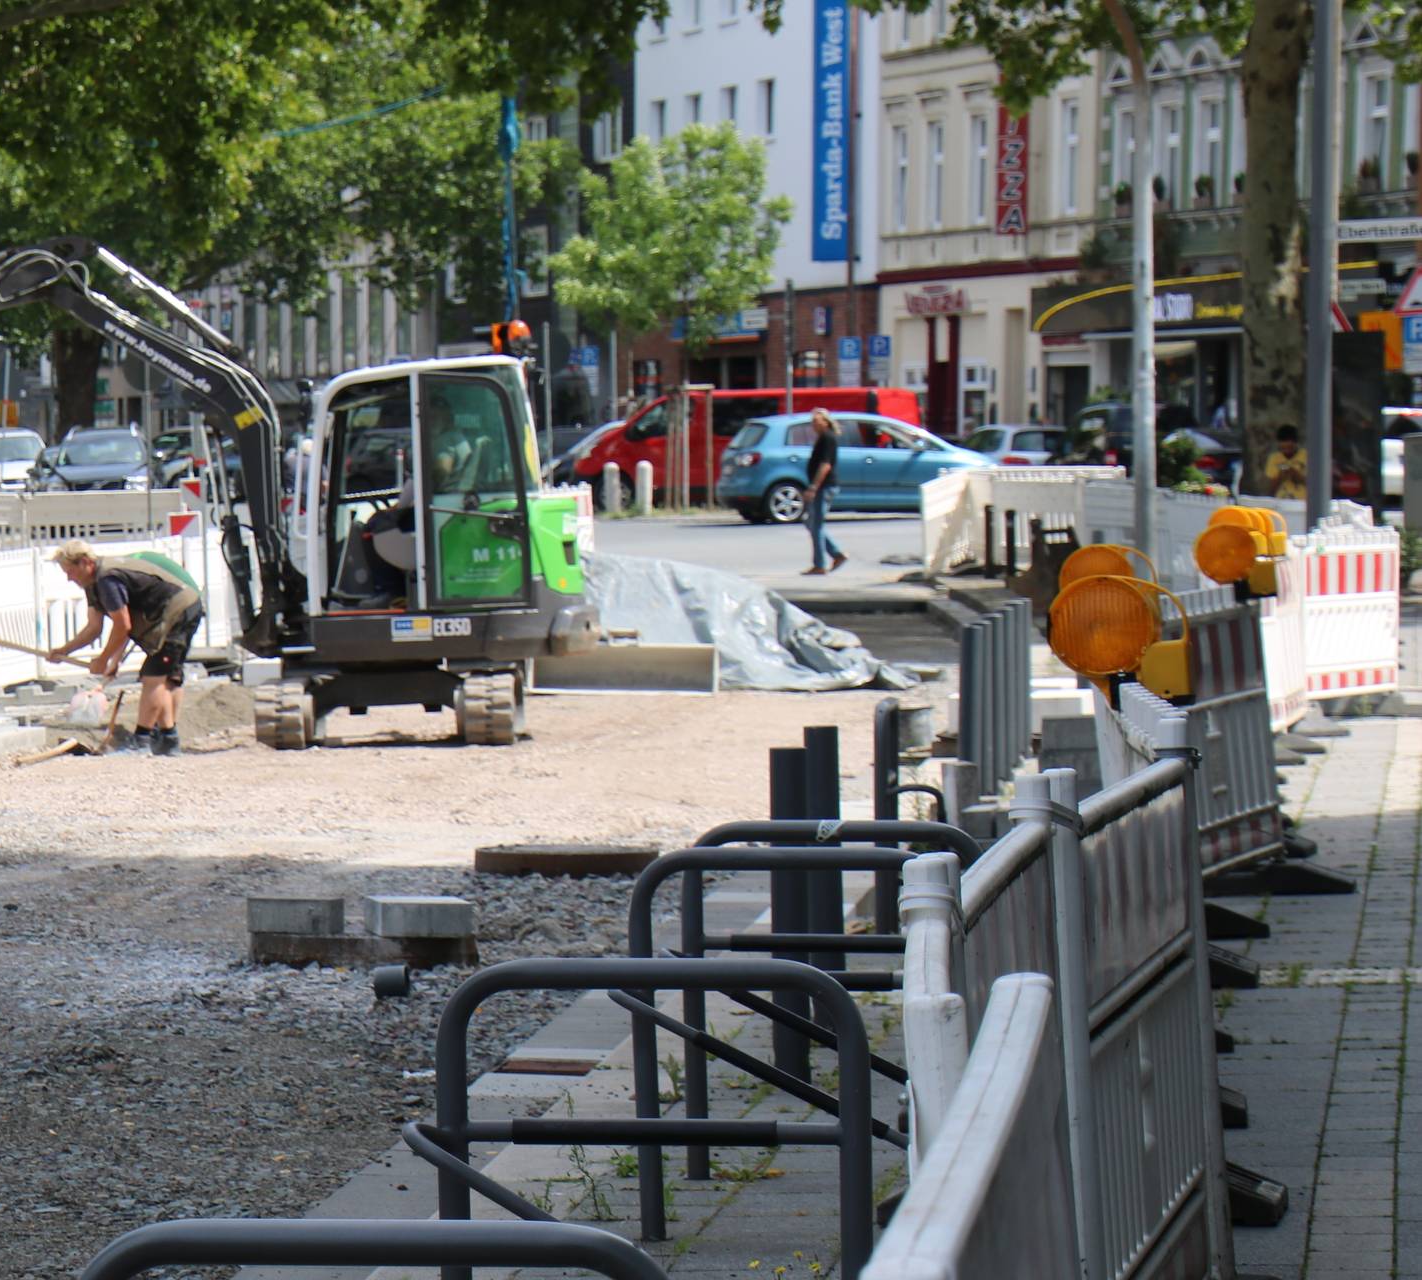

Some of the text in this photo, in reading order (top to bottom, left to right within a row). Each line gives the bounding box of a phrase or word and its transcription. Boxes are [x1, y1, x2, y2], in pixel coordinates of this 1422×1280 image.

[820, 6, 848, 241] Sparda-Bank West
[104, 320, 212, 393] www.boymann.de
[472, 545, 523, 563] M 11
